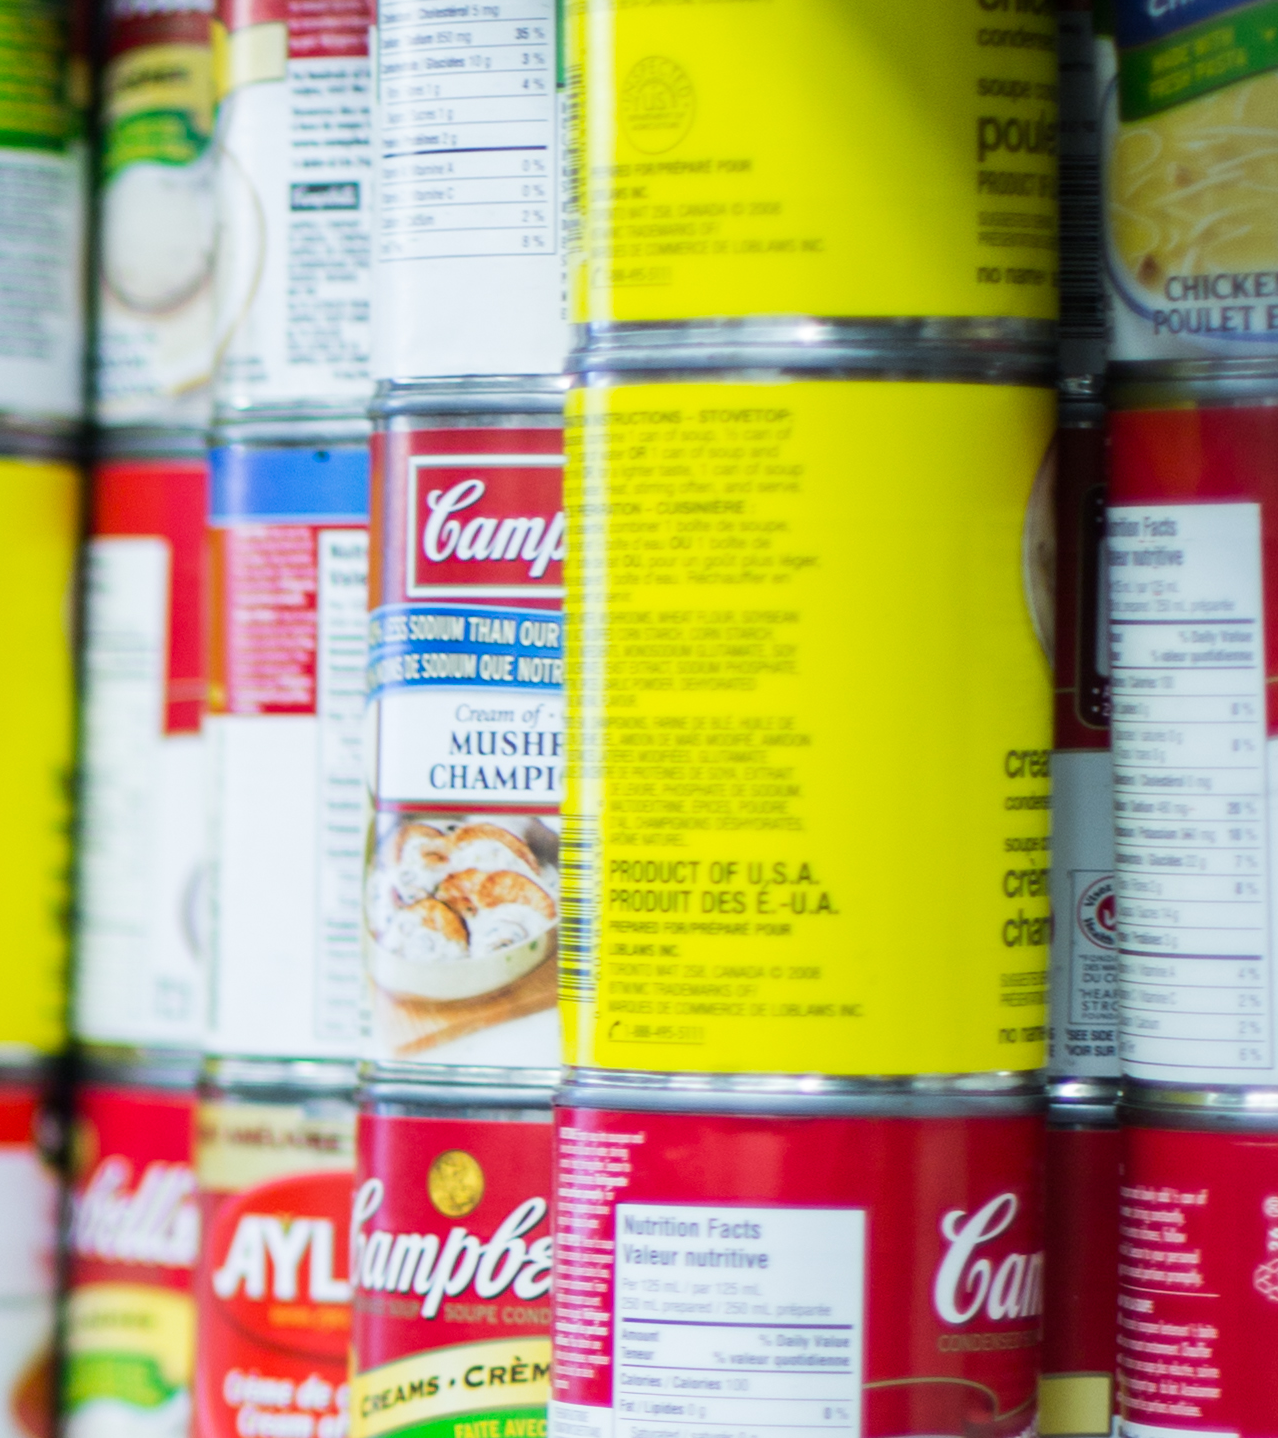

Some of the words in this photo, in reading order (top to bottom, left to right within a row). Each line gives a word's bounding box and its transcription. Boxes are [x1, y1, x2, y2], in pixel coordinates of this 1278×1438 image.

[1165, 272, 1278, 301] CHICKE
[1153, 305, 1255, 335] POULET
[410, 616, 464, 642] SODIUM
[468, 617, 516, 645] THAN
[520, 620, 560, 648] OUR
[422, 653, 476, 680] SODIUM
[480, 655, 513, 682] QUE
[456, 703, 515, 723] Cream
[522, 703, 544, 728] of
[430, 763, 563, 791] CHAMPI
[610, 860, 700, 884] PRODUCT
[709, 861, 738, 884] OF
[748, 862, 821, 885] U.S.A.
[610, 889, 692, 914] PRODUIT
[702, 890, 746, 914] DES
[623, 1214, 700, 1238] Nutrition
[707, 1217, 762, 1239] Facts
[623, 1242, 679, 1266] Valeur
[684, 1247, 769, 1269] nutritive
